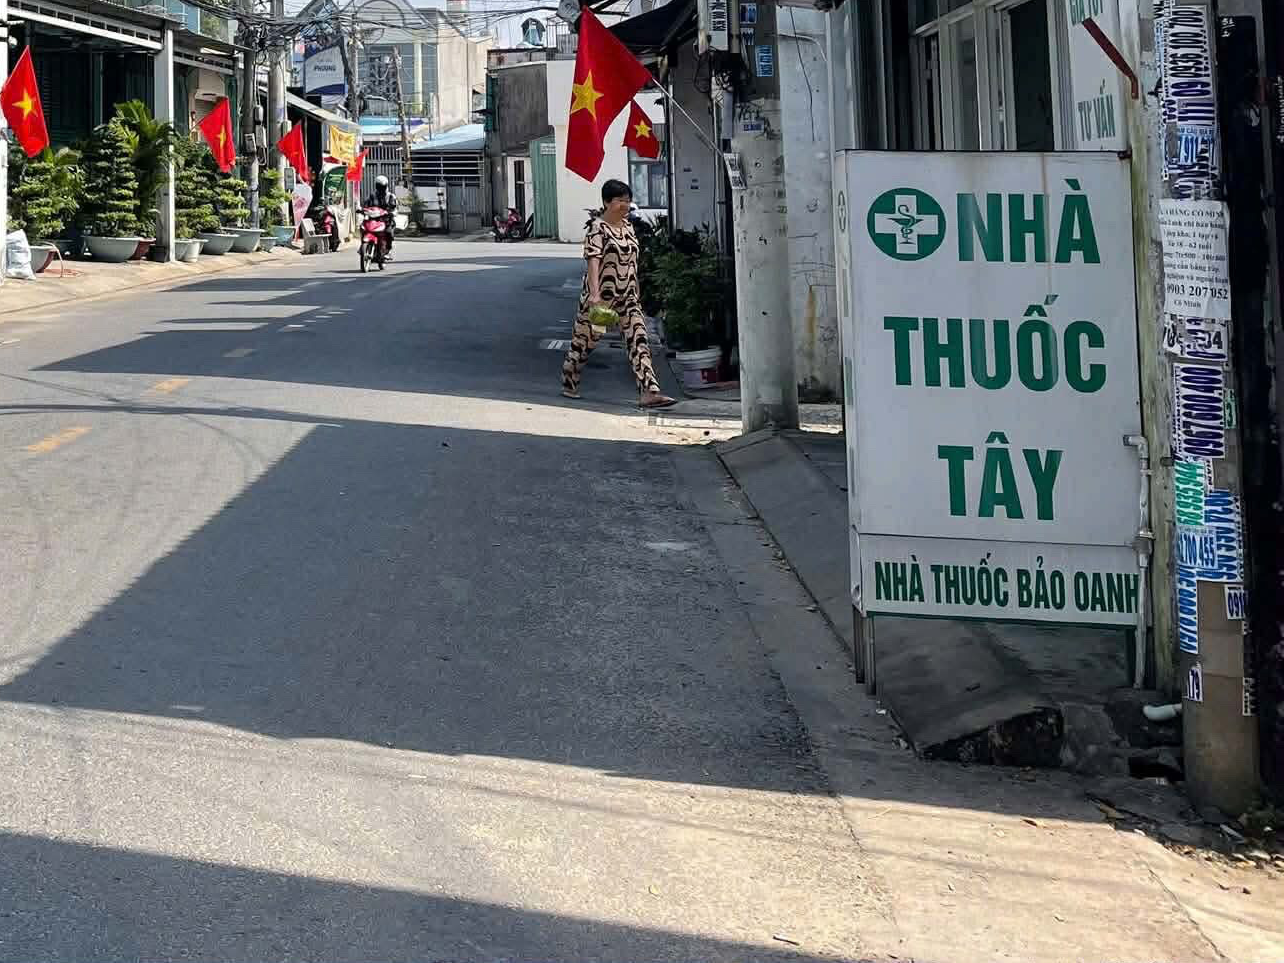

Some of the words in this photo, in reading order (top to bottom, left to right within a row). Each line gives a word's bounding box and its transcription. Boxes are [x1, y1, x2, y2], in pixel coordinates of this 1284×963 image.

[1093, 78, 1116, 138] VẤN
[956, 178, 1101, 264] NHÀ
[1189, 285, 1208, 297] 207
[1210, 287, 1229, 300] 052
[883, 294, 1107, 393] THUỐC
[1180, 365, 1225, 457] 0967.600.400
[937, 431, 1064, 521] TÂY
[874, 554, 924, 603] NHÀ
[930, 552, 1009, 607] THUỐC
[1016, 555, 1066, 611] BẢO
[1074, 571, 1140, 614] OANH
